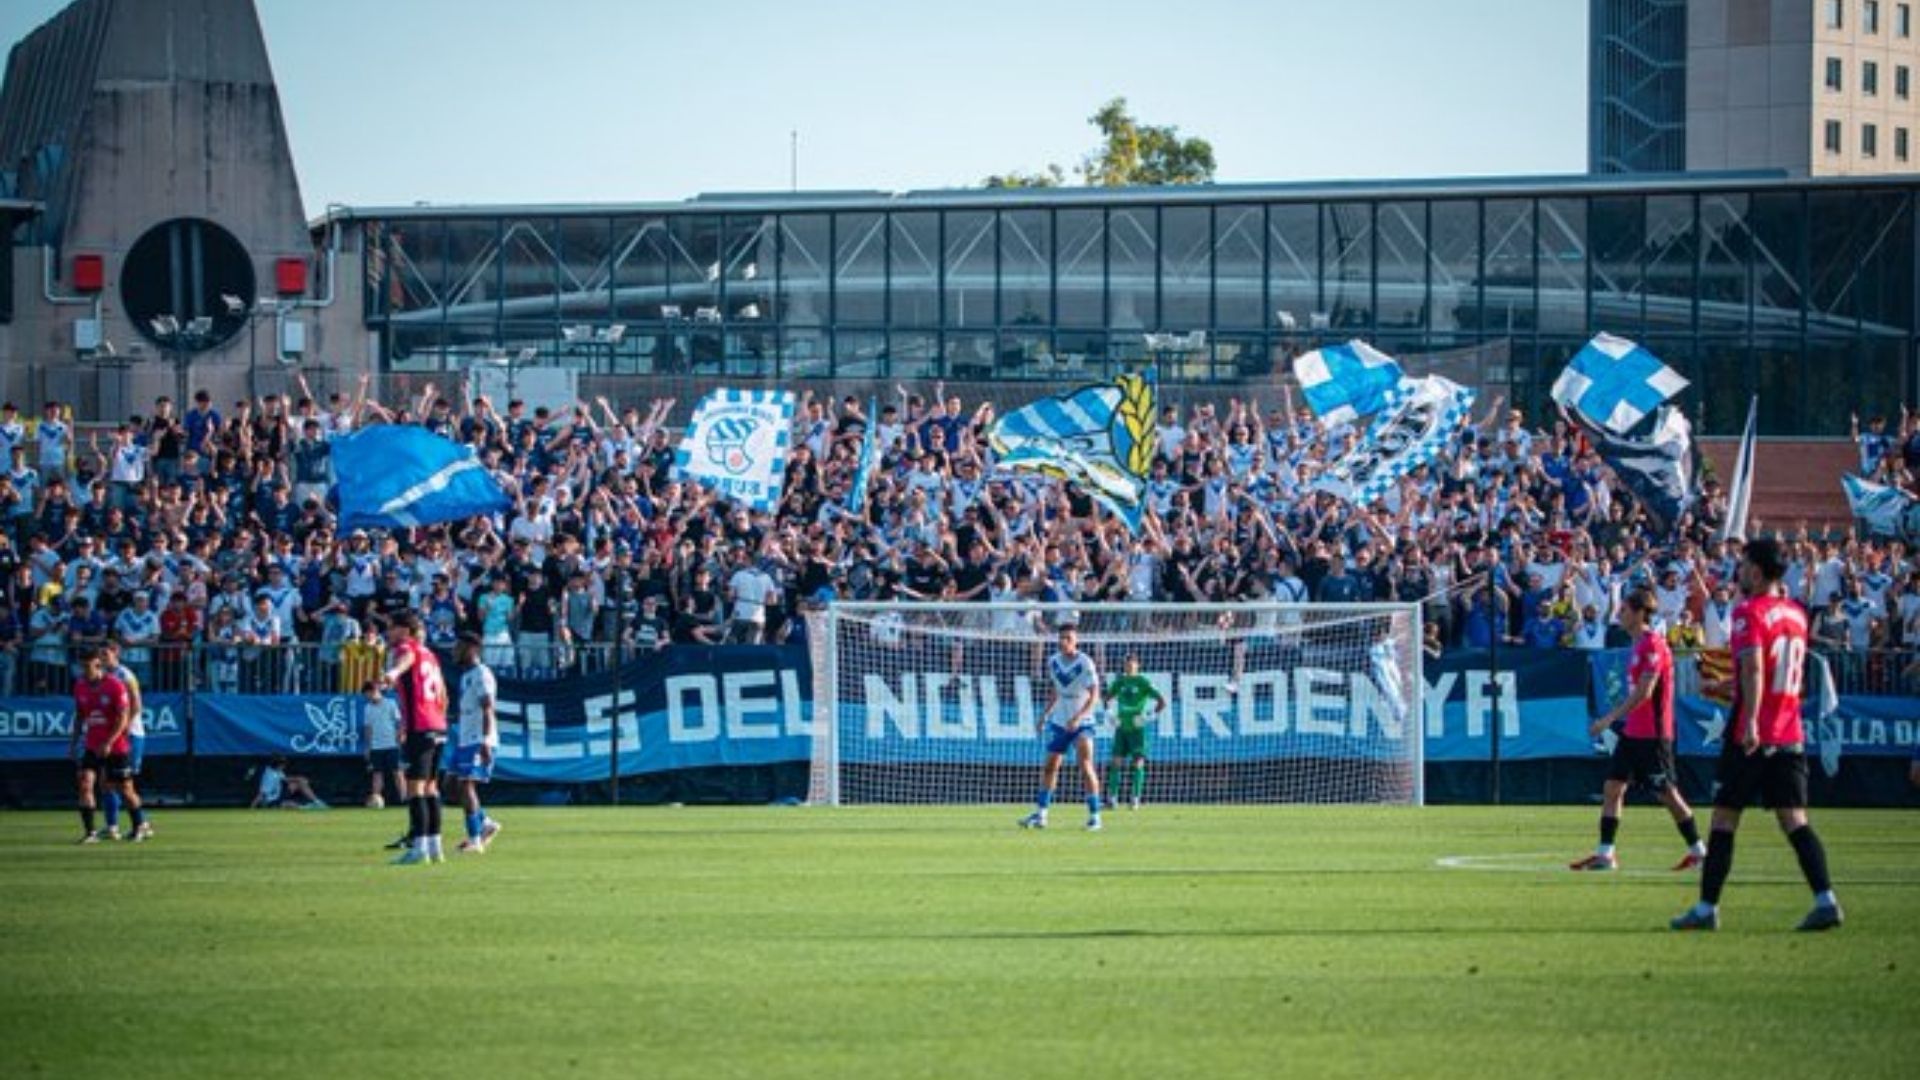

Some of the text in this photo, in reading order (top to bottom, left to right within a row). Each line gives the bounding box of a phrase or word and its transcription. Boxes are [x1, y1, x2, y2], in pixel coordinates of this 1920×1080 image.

[1770, 634, 1806, 695] 18
[665, 670, 828, 743] DEL
[864, 672, 1037, 739] NOU
[1894, 718, 1920, 745] D
